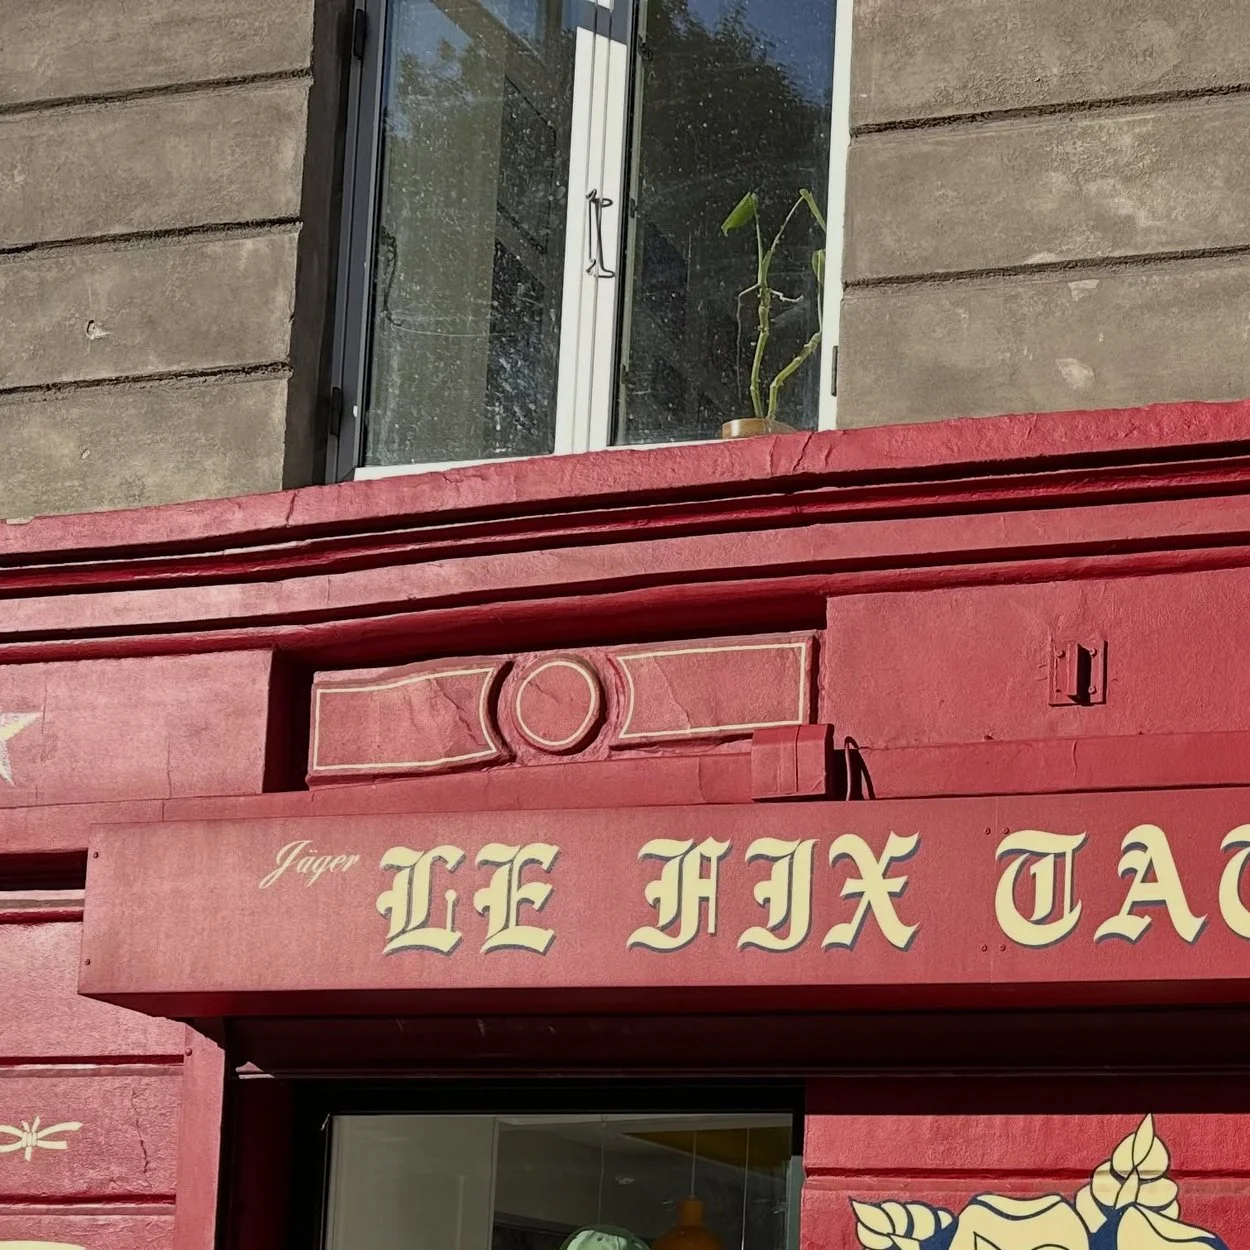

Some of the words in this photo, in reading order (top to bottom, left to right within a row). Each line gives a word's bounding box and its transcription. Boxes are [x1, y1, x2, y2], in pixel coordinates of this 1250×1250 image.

[258, 838, 361, 889] Jäger
[376, 841, 562, 956] LE
[625, 830, 923, 952] FIX
